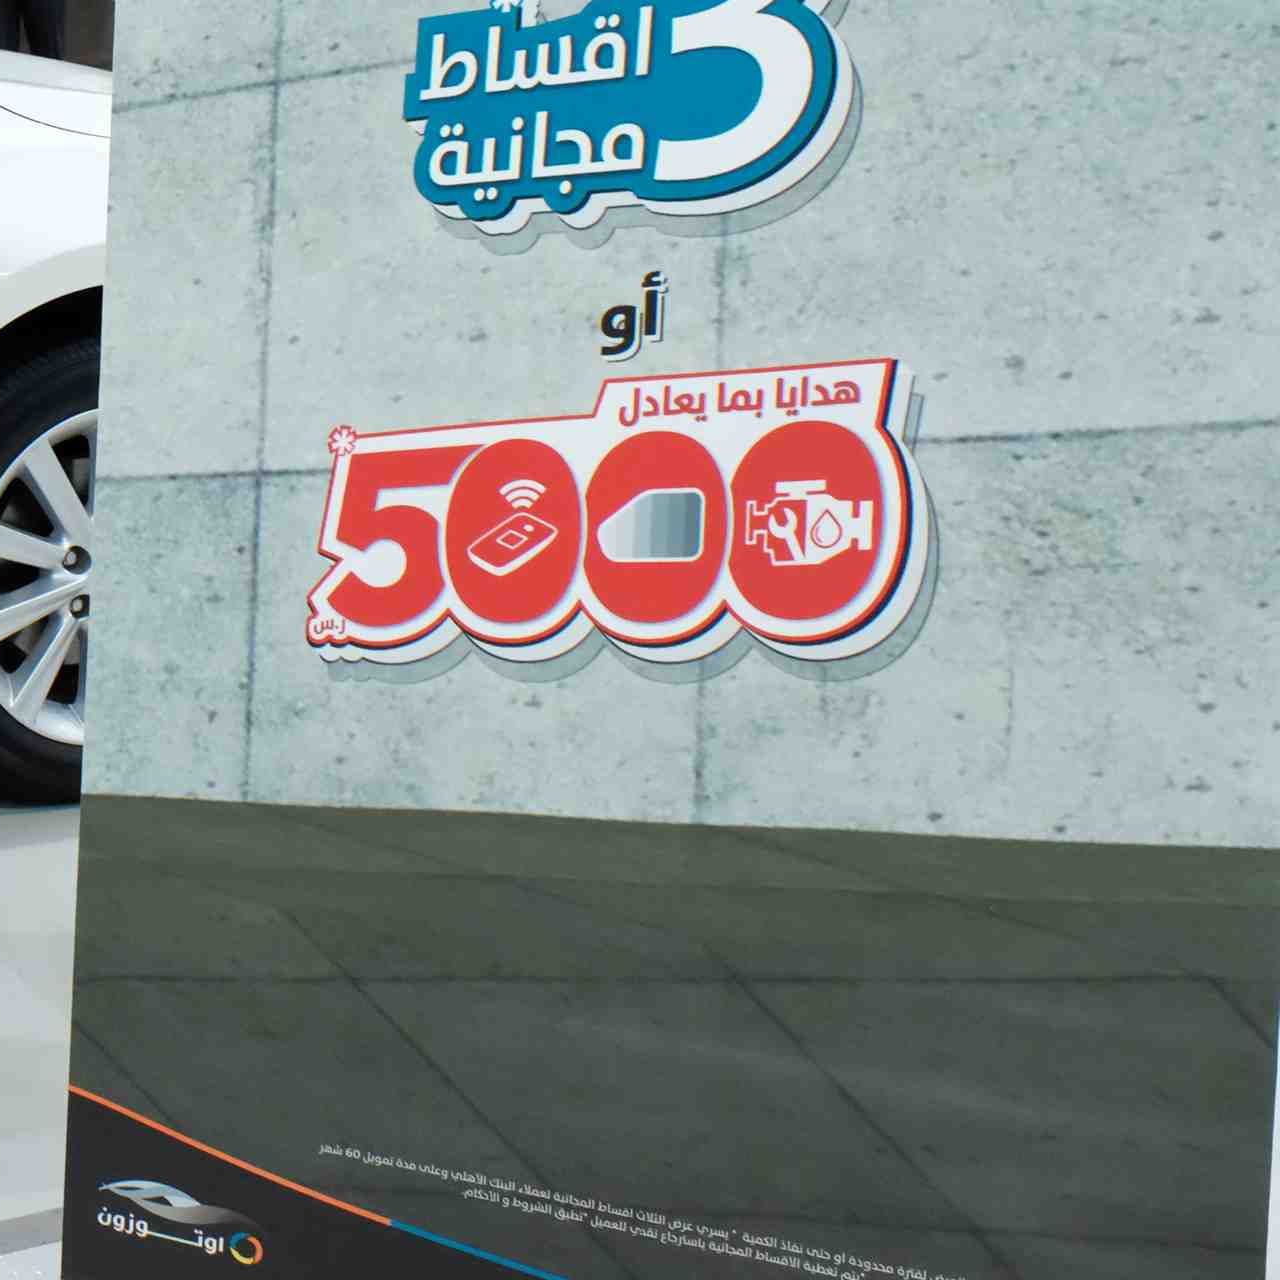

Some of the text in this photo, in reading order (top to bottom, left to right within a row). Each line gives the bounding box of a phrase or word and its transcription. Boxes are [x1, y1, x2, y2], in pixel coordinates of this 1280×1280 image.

[419, 5, 654, 102] اقساط
[428, 110, 645, 202] مجانية
[600, 270, 667, 357] أو
[618, 375, 861, 427] هدايا بما يعادل
[324, 419, 884, 628] 5000
[318, 1143, 343, 1157] شهر
[345, 1147, 361, 1160] 60
[848, 1256, 894, 1274] محدودة
